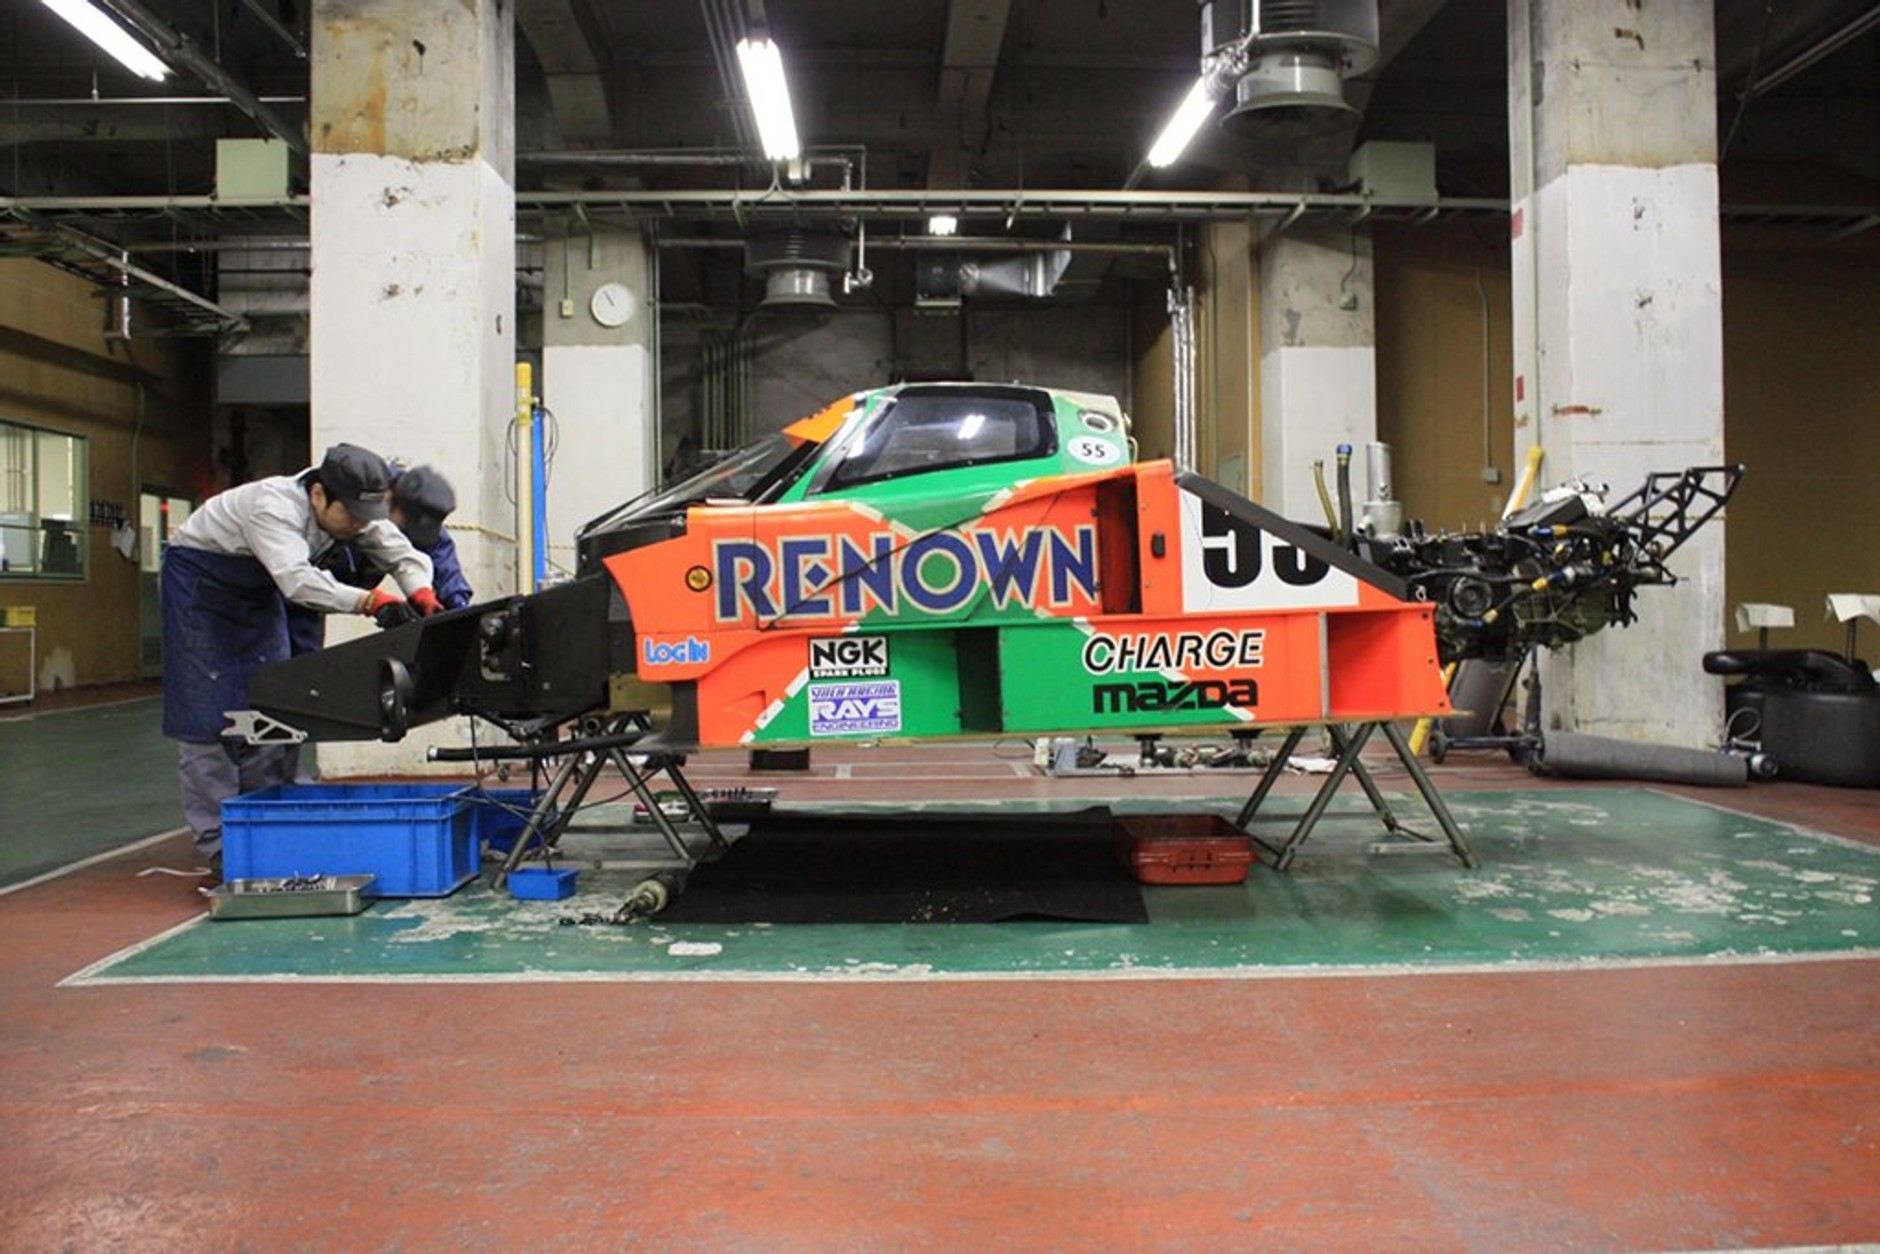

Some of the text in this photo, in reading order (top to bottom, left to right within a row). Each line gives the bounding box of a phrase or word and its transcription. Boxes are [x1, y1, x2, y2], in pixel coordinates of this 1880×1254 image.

[1082, 442, 1105, 458] 55
[712, 524, 1100, 622] RENOWN
[812, 639, 884, 667] NGK
[1083, 630, 1264, 674] CHARGE
[812, 697, 898, 721] RAYS
